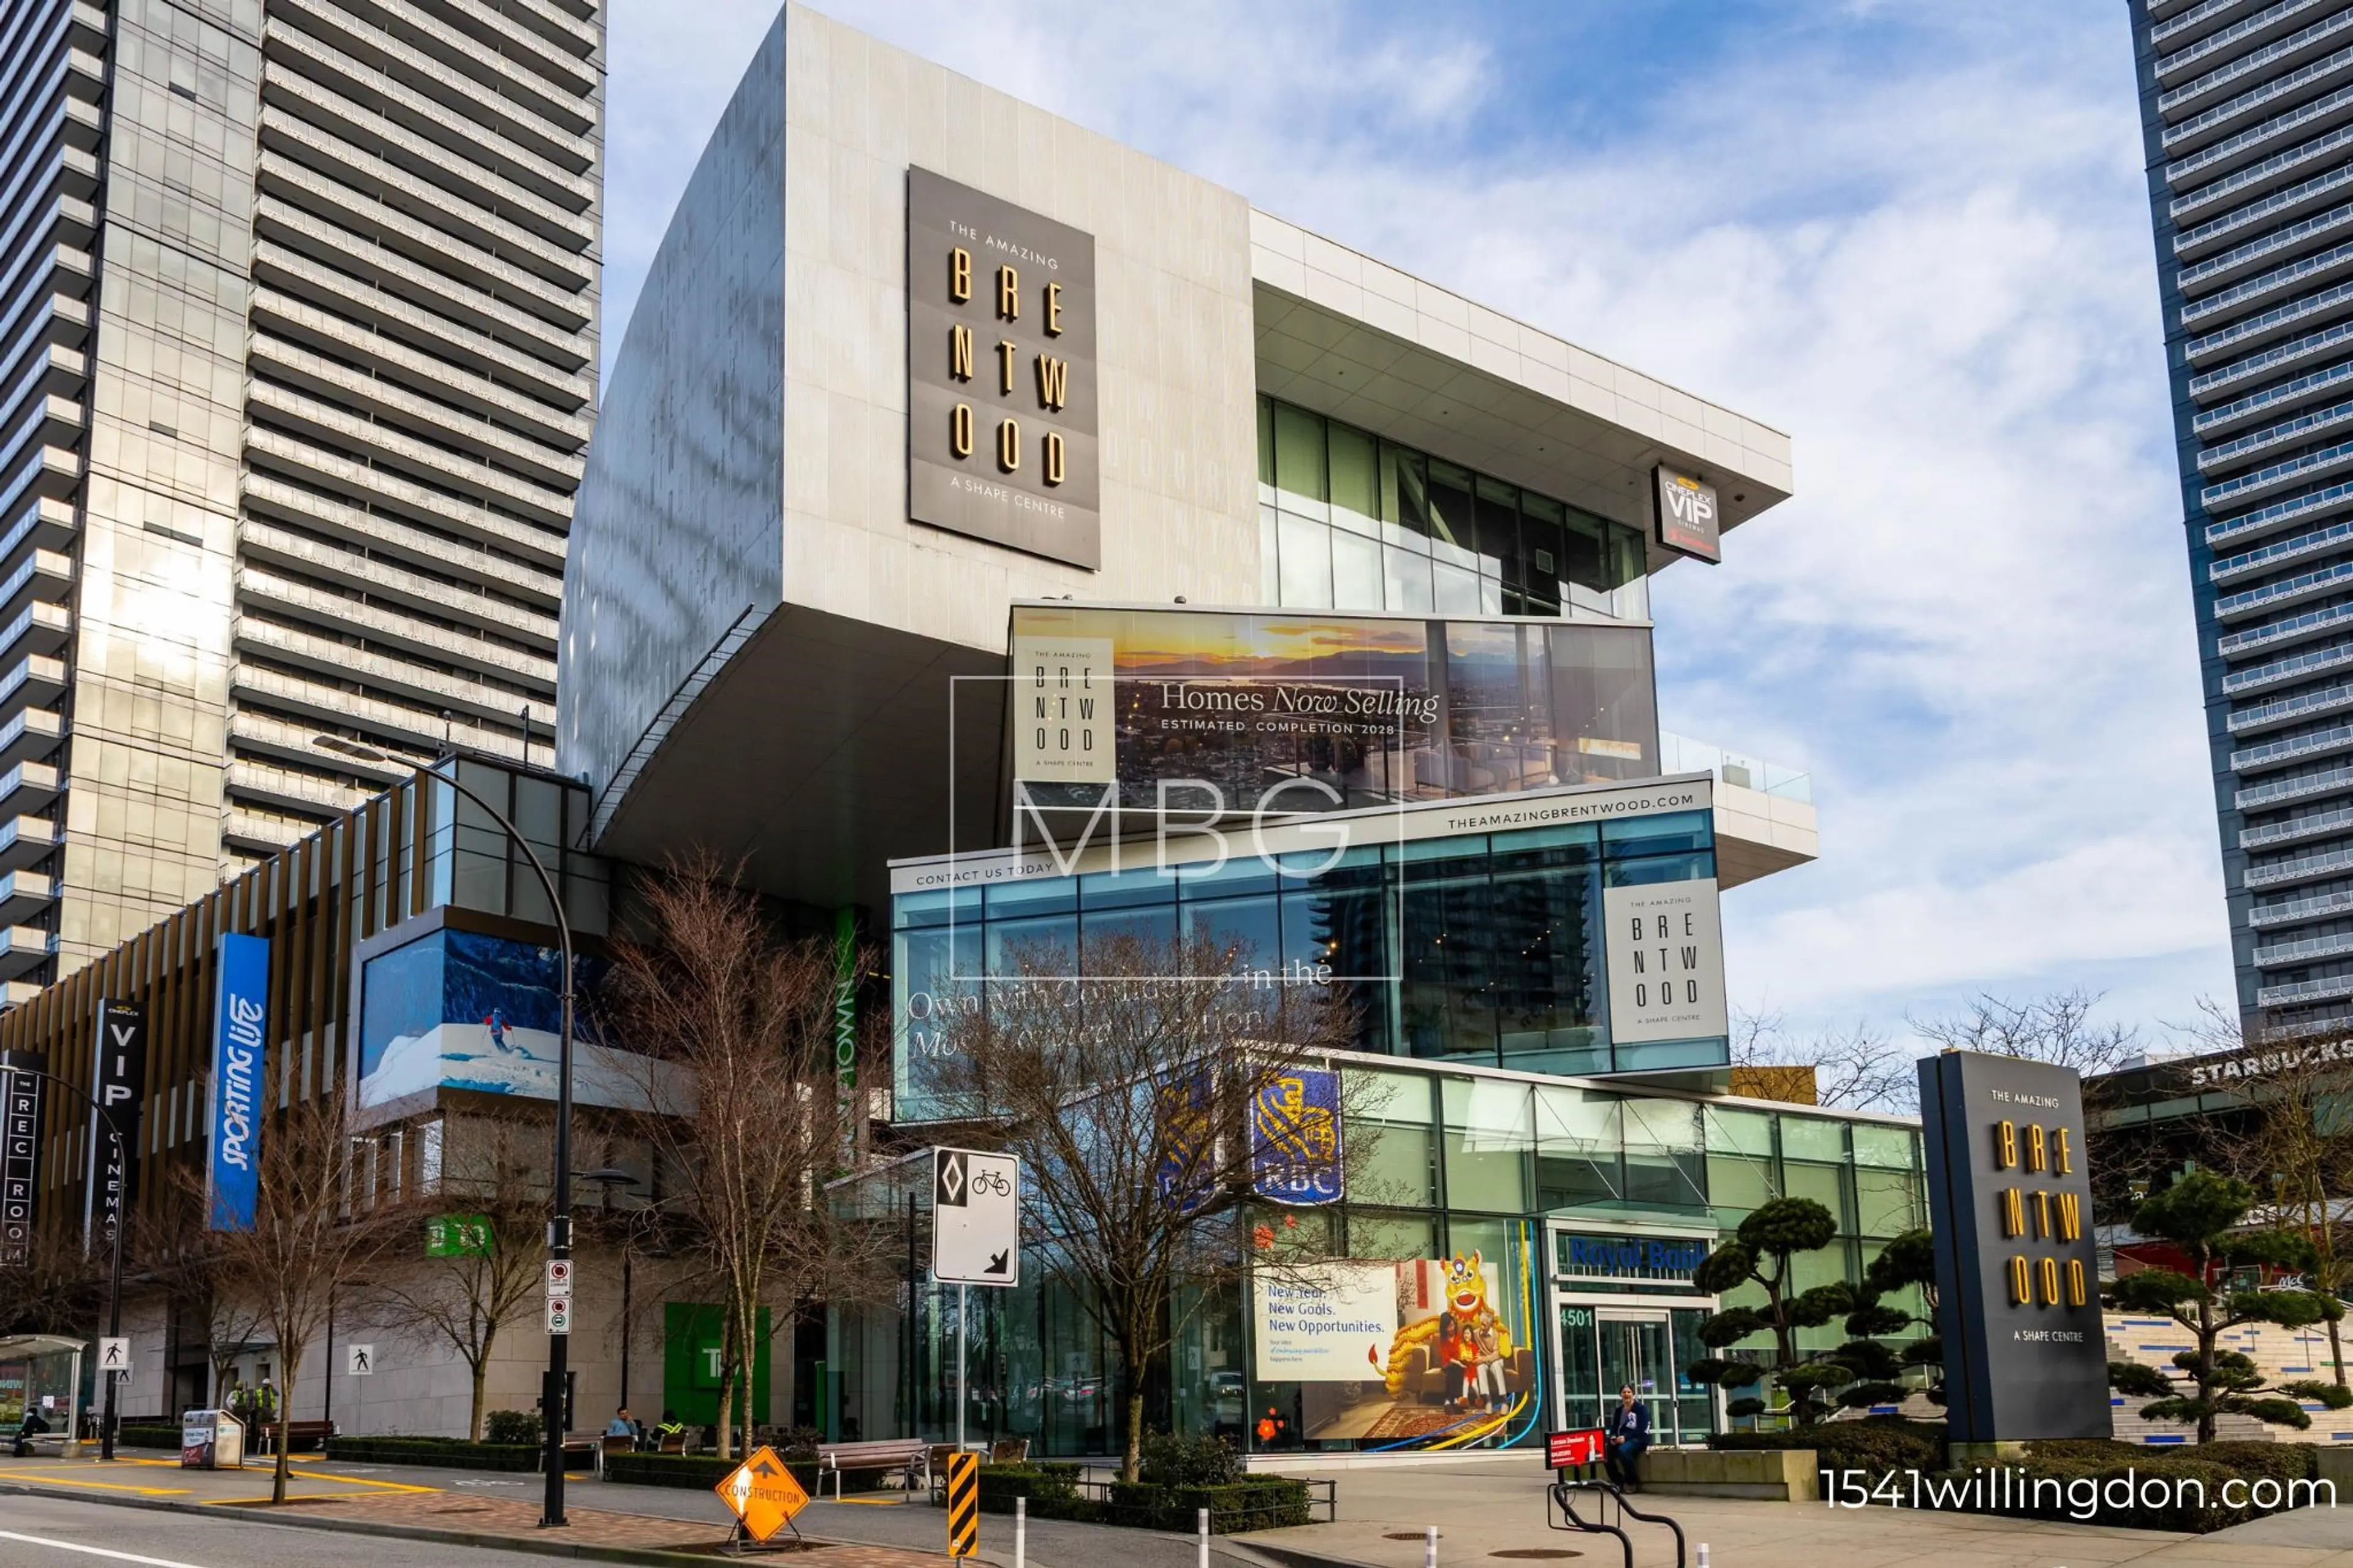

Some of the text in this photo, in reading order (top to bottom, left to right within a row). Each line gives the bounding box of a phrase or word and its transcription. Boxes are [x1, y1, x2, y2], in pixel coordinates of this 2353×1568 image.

[950, 221, 1058, 270] THE AMAZING
[951, 476, 1065, 518] A SHAPE CENTRE
[1666, 490, 1712, 524] VIP
[1162, 684, 1440, 724] Homes Now Selling
[1161, 719, 1394, 735] ESTIMATED COMPLETION 2028
[1448, 795, 1693, 830] THEAMAZINGBRENTWOOD.COM
[916, 863, 1053, 885] CONTACT US TODAY
[1650, 897, 1692, 906] AMAZING
[909, 991, 979, 1020] Own
[1280, 958, 1333, 987] the
[1991, 1089, 2059, 1109] THE AMAZING
[1571, 1237, 1642, 1273] Royal
[1268, 1285, 1293, 1297] New
[1268, 1303, 1336, 1316] New Goals.
[1560, 1309, 1593, 1327] 4501
[1269, 1319, 1385, 1335] New Opportunities.
[2014, 1330, 2083, 1342] A SHAPE CENTRE
[724, 1483, 800, 1504] CONSTRUCTION
